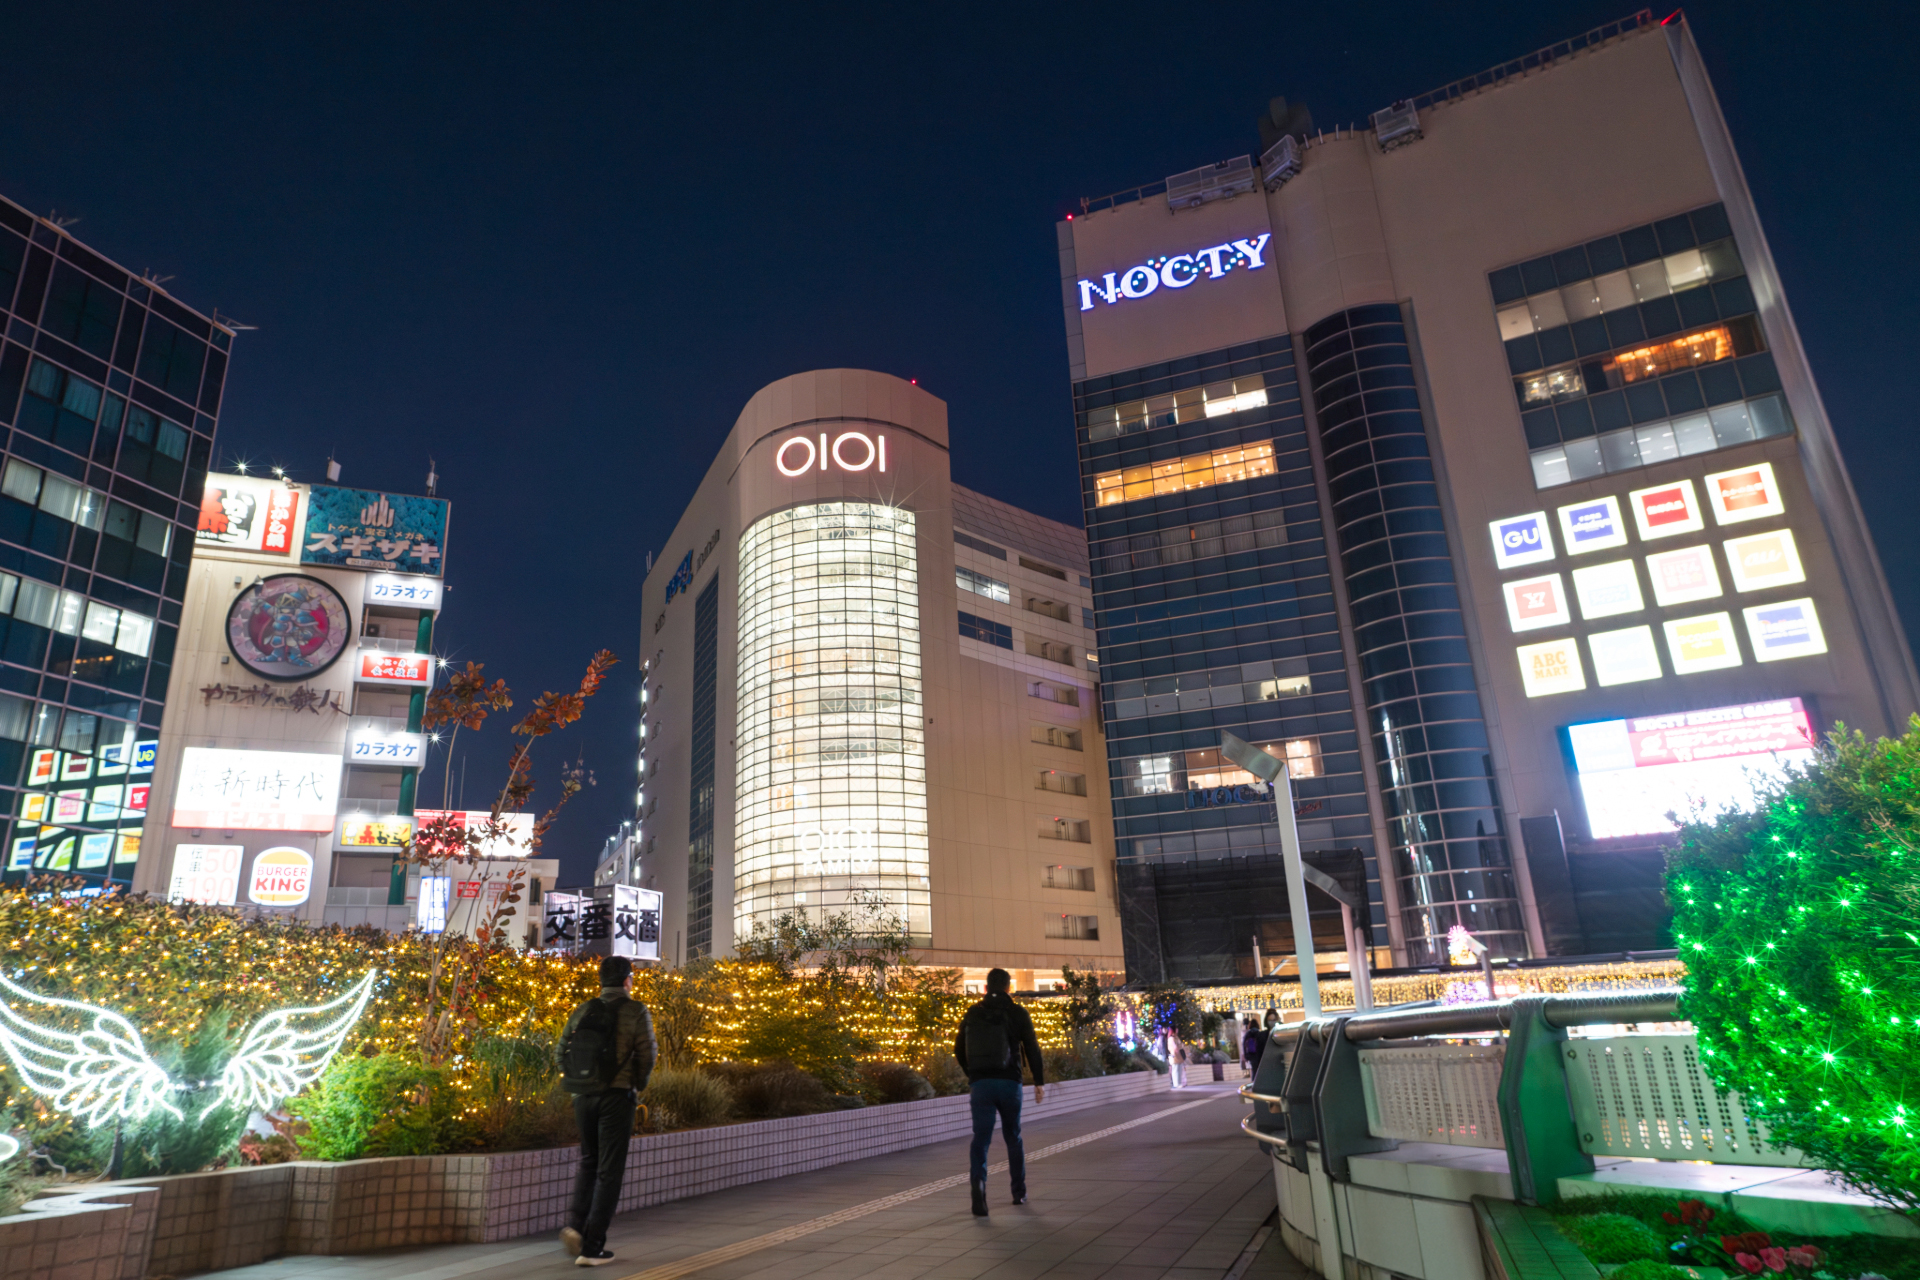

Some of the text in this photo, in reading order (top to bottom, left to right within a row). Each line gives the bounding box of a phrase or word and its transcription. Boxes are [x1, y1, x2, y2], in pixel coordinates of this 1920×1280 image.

[1078, 233, 1271, 311] NOCTY
[306, 532, 441, 564] スギザキ
[1504, 527, 1540, 548] GU
[1743, 549, 1783, 566] au
[374, 583, 434, 600] カラオケ
[1532, 651, 1567, 669] ABC
[1534, 664, 1569, 680] MART
[200, 683, 352, 716] カラオケの鉄人
[355, 741, 418, 757] カラオケ
[215, 767, 325, 801] 新時代
[204, 848, 238, 873] 50
[257, 866, 307, 877] BURGER
[185, 877, 235, 903] 190
[256, 878, 306, 892] KING
[545, 904, 612, 942] 交番
[615, 904, 659, 942] 交番
